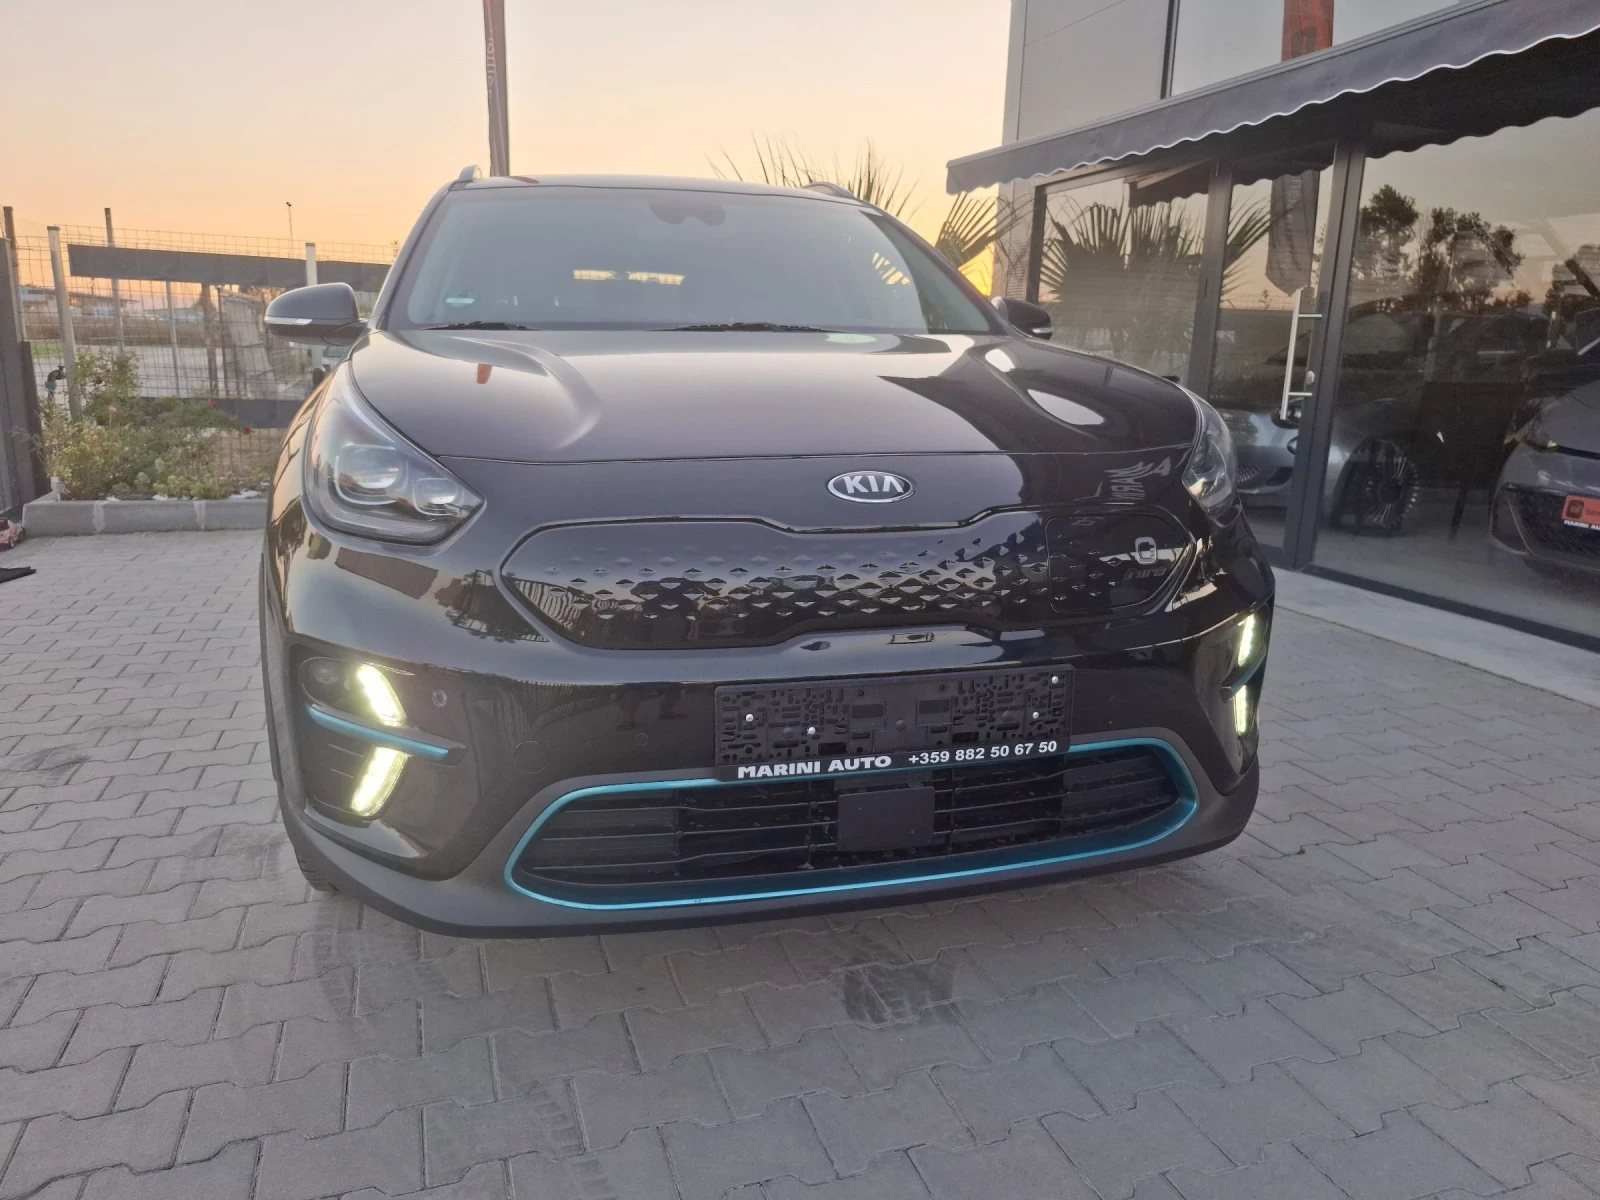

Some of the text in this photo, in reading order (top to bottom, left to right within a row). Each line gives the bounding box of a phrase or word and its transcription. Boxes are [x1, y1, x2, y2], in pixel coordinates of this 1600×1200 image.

[842, 475, 904, 494] KIA
[737, 740, 1058, 778] MARINI AUTO +359 882 50 67 50
